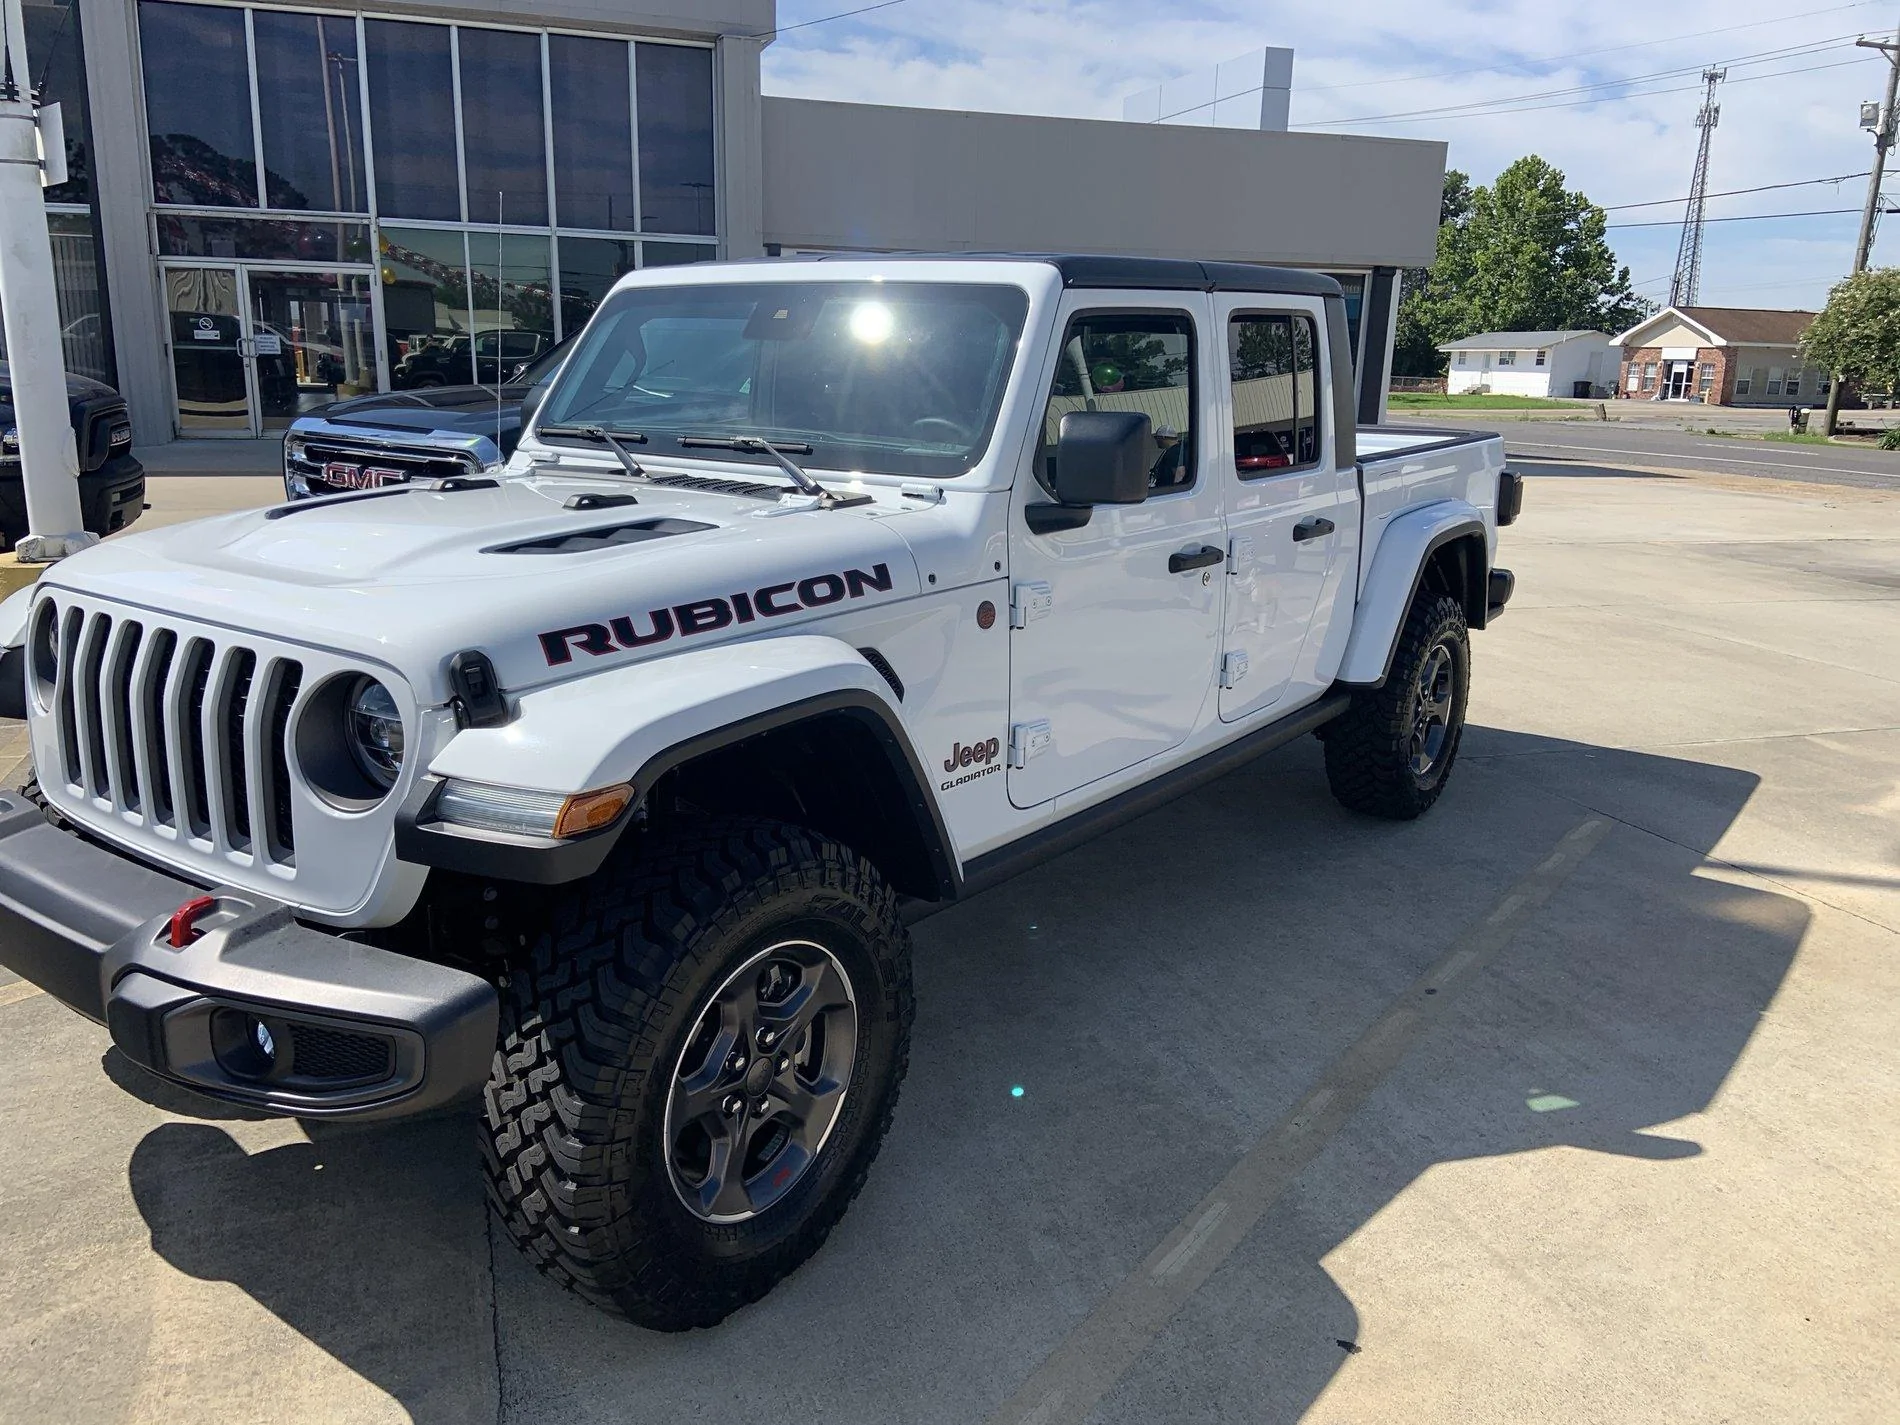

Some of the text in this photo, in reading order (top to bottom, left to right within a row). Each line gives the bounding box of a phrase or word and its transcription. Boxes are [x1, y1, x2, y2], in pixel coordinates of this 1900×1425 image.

[321, 461, 404, 490] GMC
[537, 562, 893, 667] RUBICON
[943, 737, 1000, 773] Jeep
[940, 764, 1001, 791] GLADIATOR
